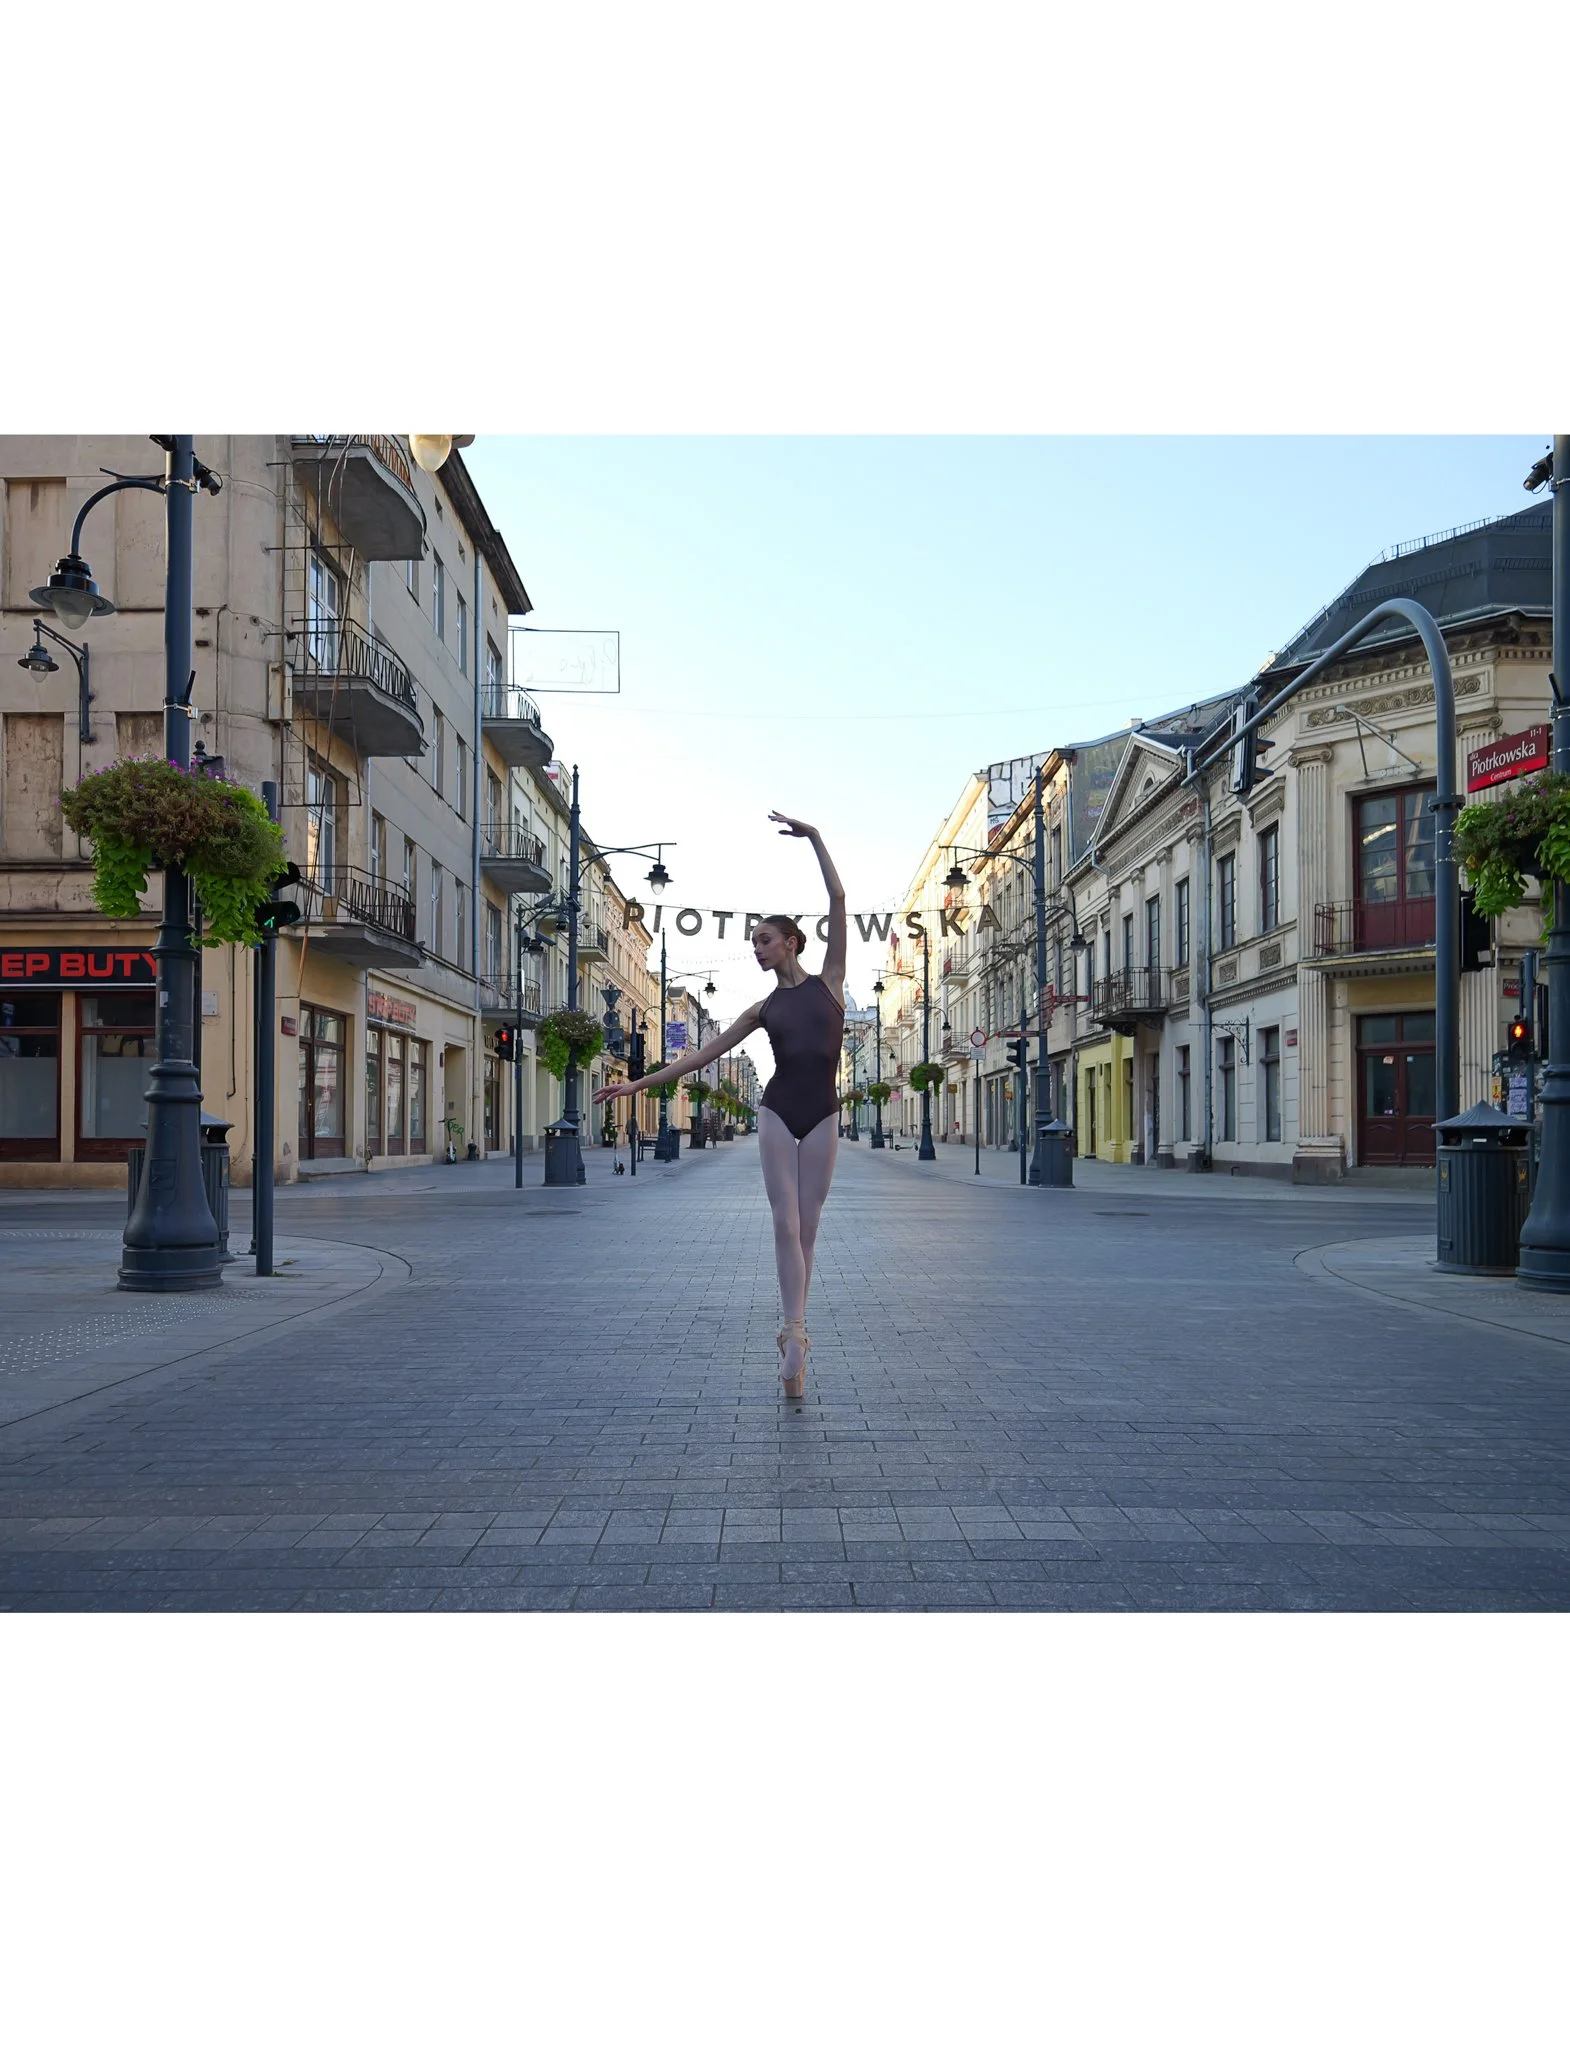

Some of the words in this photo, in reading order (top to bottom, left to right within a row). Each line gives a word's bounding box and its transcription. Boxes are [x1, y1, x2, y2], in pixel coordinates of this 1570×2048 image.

[1472, 741, 1536, 777] Piotrkowska
[1490, 770, 1512, 781] Centrum
[622, 901, 1001, 942] PIOTRWSKA
